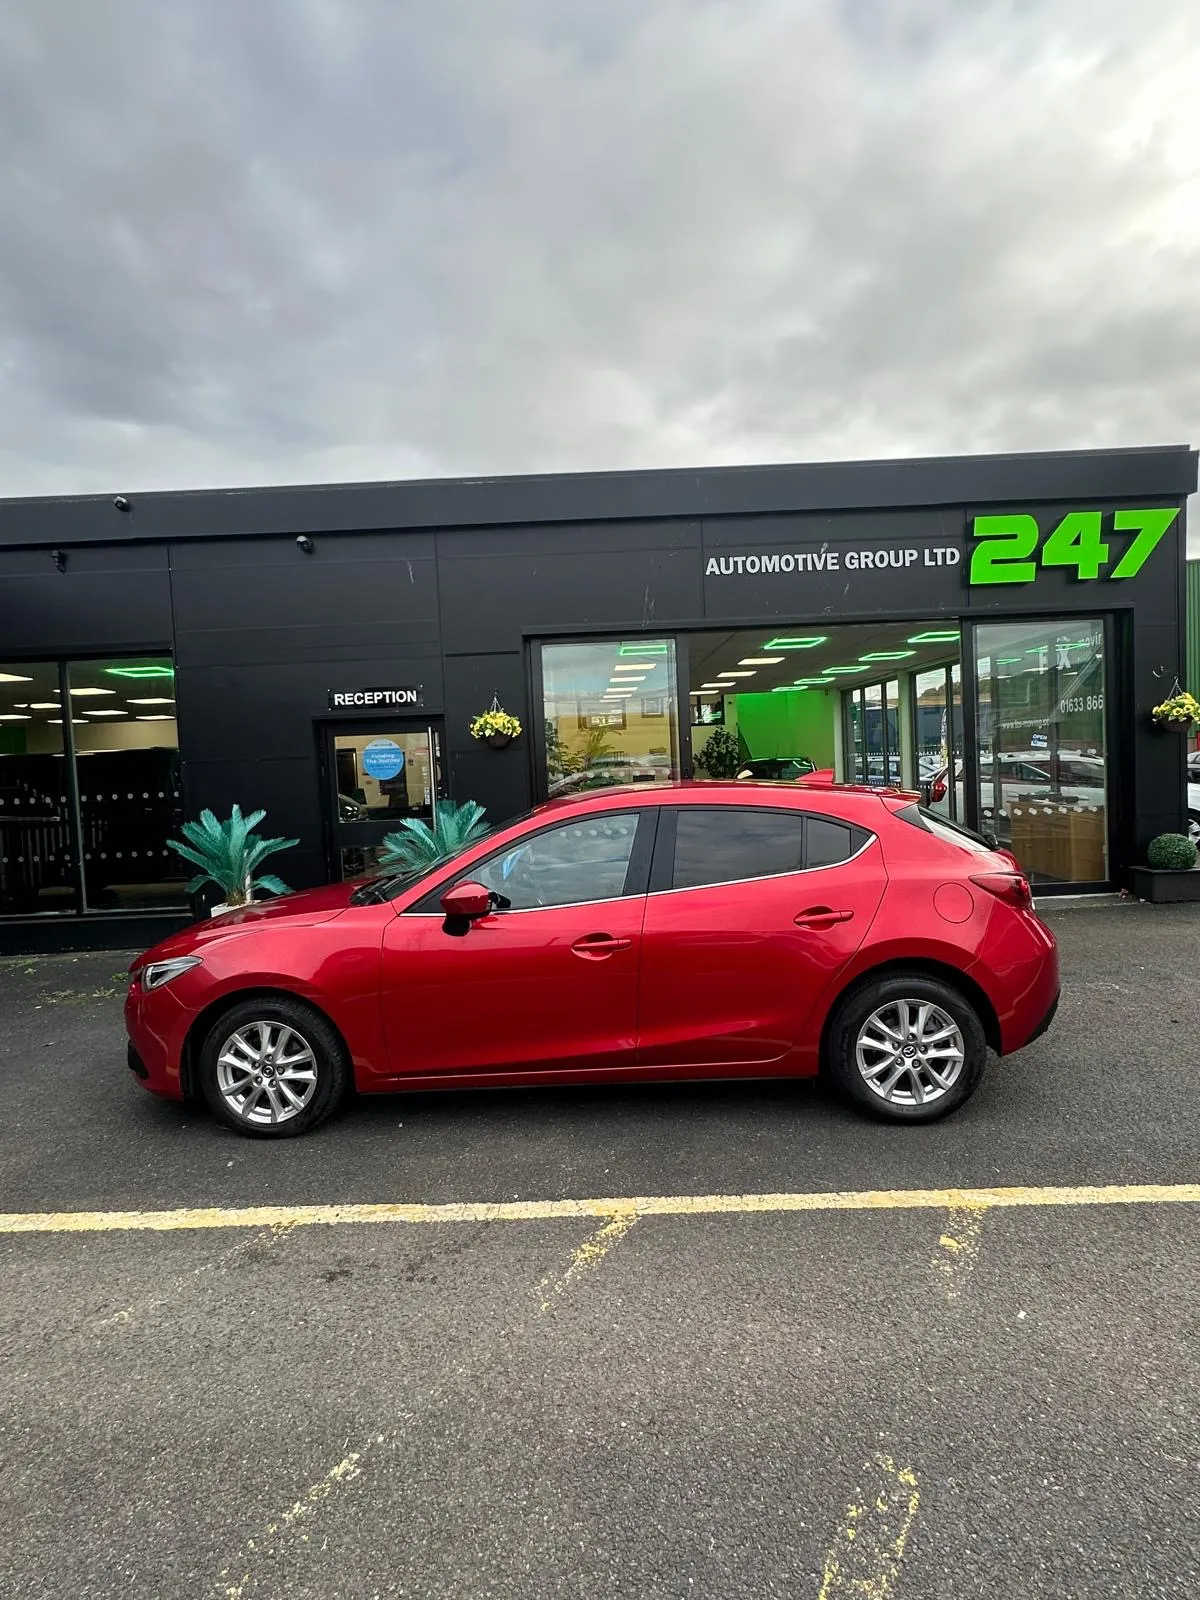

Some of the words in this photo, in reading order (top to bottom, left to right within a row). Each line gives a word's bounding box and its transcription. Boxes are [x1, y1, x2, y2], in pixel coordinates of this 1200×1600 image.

[969, 507, 1182, 585] 247
[705, 552, 840, 576] AUTOMOTIVE
[844, 549, 919, 570] GROUP
[924, 547, 961, 567] LTD
[334, 690, 418, 706] RECEPTION
[1060, 697, 1084, 714] 01633
[1086, 694, 1104, 711] 866
[1032, 733, 1048, 741] OPEN
